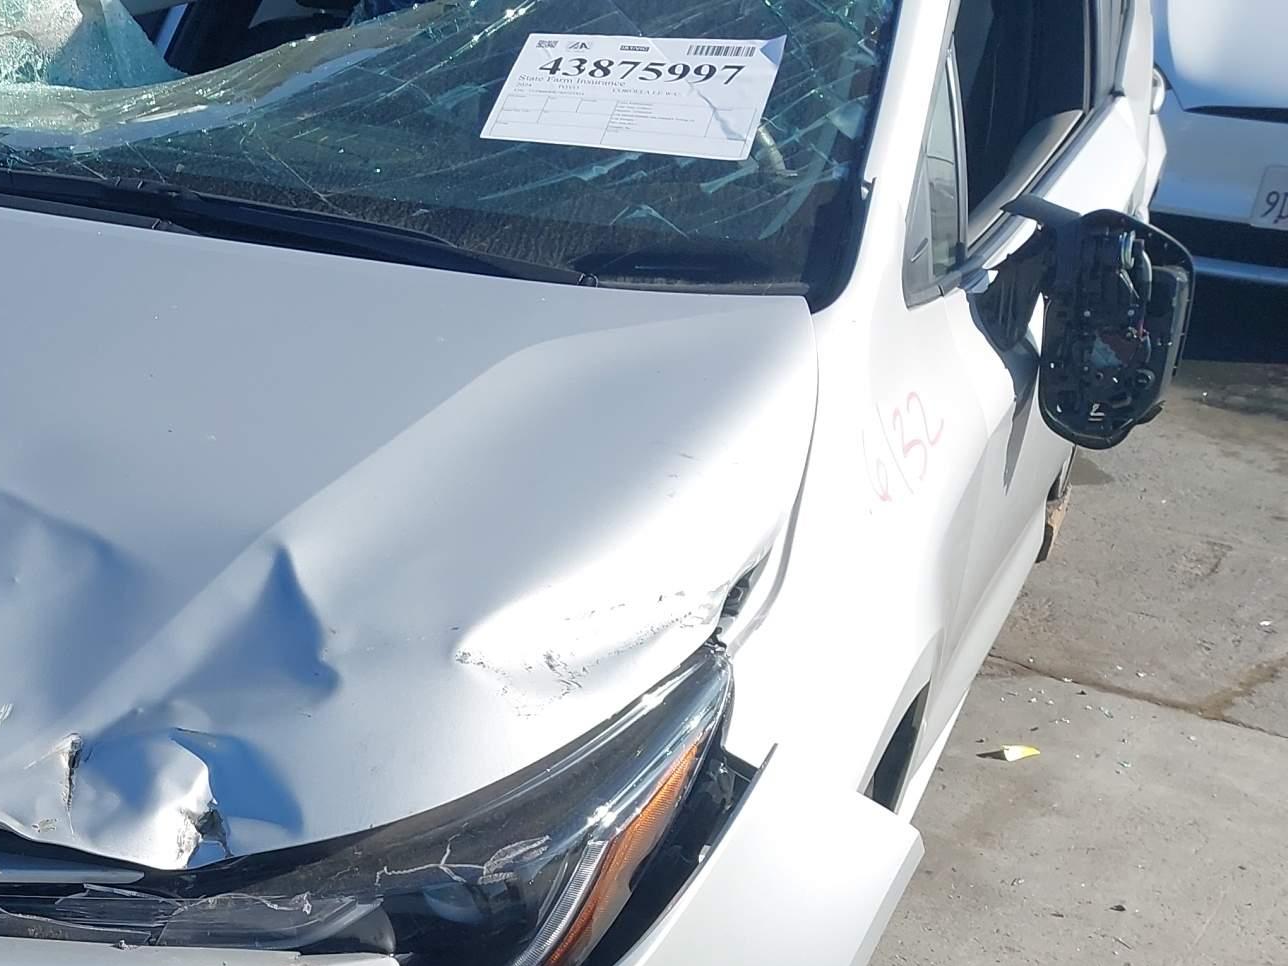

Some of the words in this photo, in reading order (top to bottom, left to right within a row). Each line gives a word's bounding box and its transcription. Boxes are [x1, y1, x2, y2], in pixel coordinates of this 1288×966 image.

[517, 74, 545, 83] State
[546, 76, 573, 85] Farm
[575, 78, 627, 88] Insurance
[538, 56, 745, 86] 43875997
